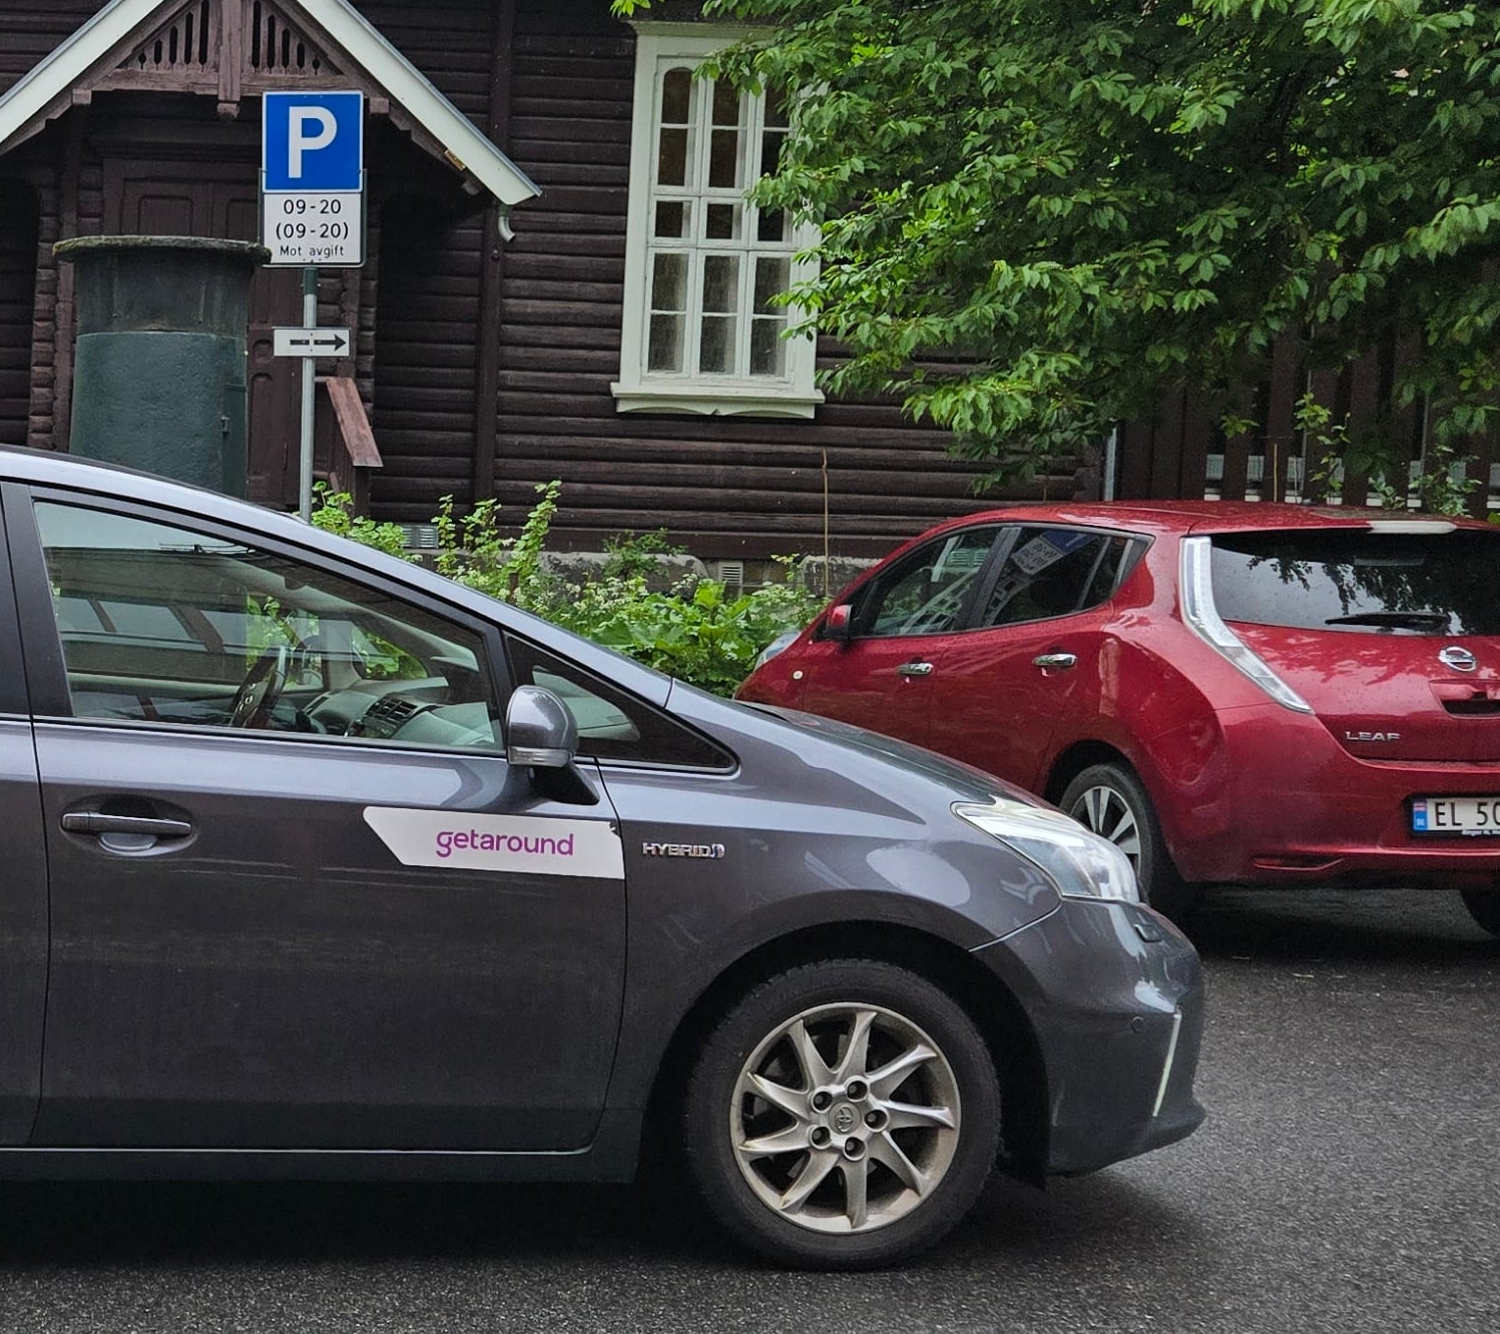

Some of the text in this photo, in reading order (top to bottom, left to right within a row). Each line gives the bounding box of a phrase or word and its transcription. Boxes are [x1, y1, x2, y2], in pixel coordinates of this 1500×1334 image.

[288, 106, 337, 178] P
[283, 199, 341, 214] 09-20
[276, 222, 348, 240] (09-20)
[280, 245, 344, 259] Mot avgift
[1346, 731, 1401, 741] LEAF
[1435, 801, 1462, 826] EL
[436, 828, 574, 858] getaround
[642, 842, 711, 857] HYBRID
